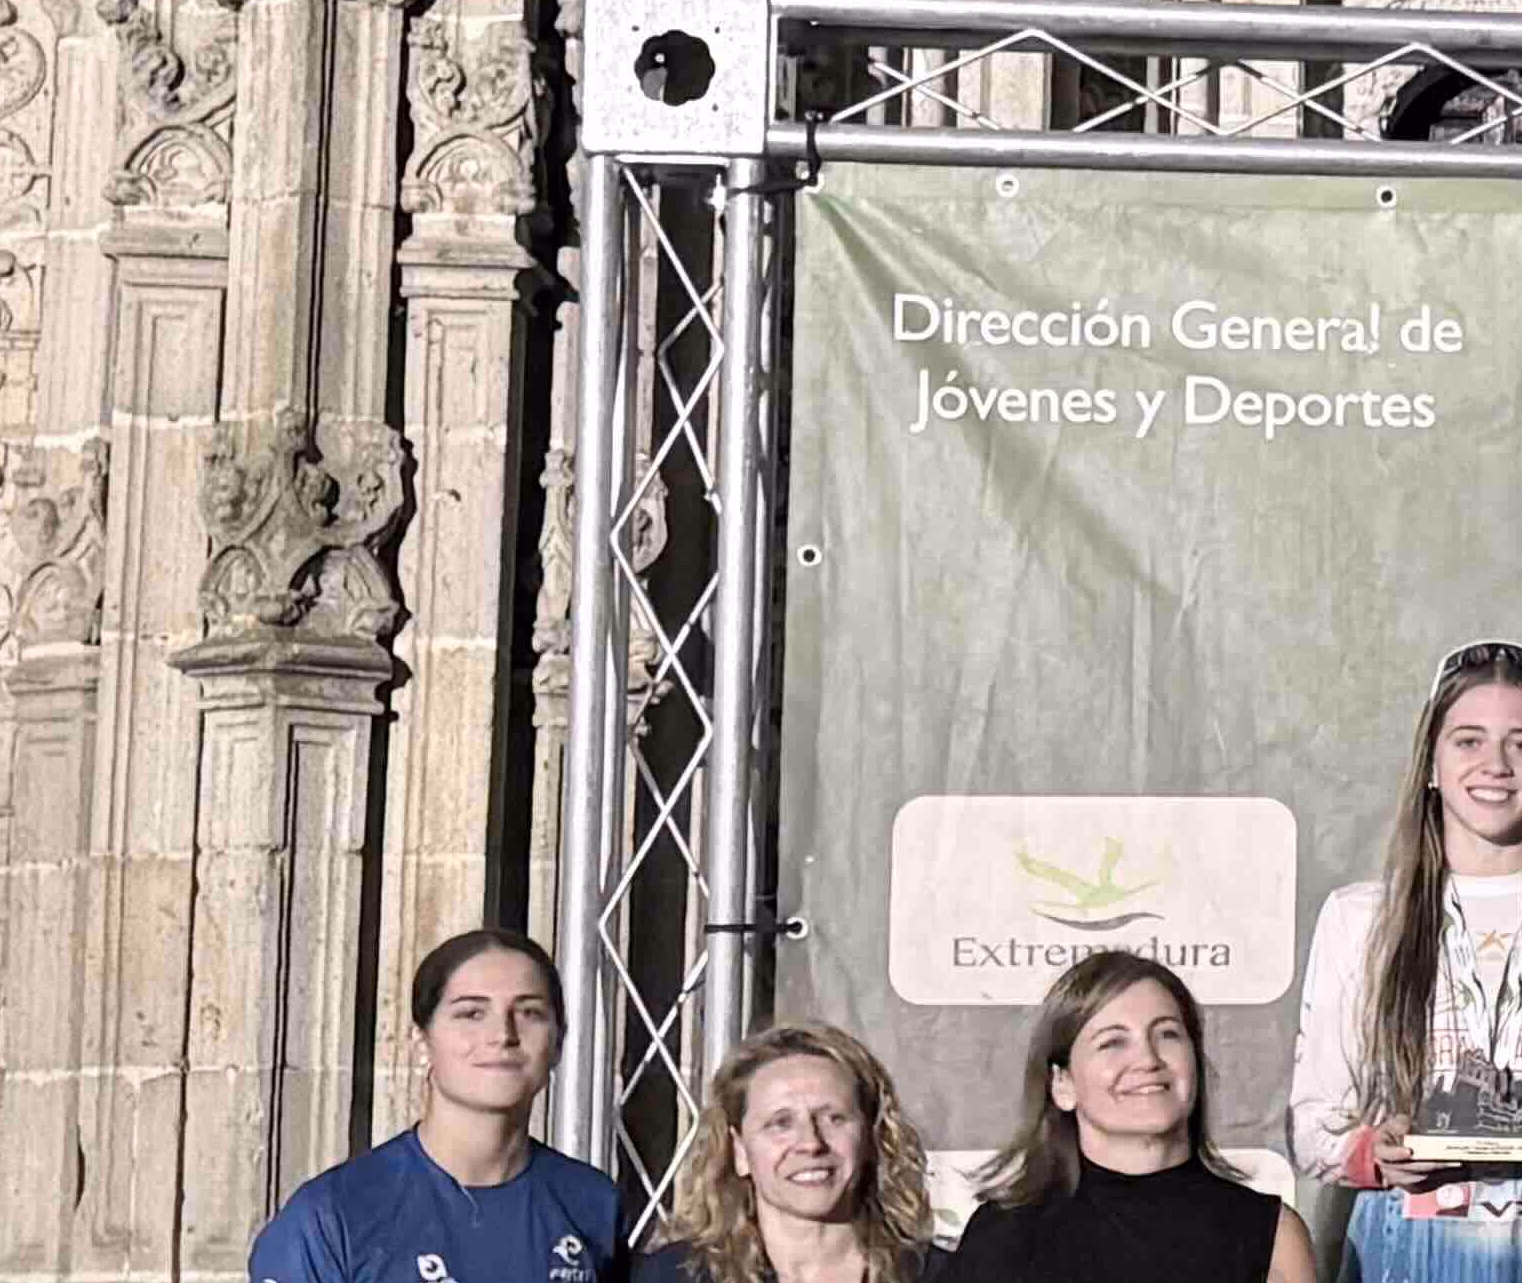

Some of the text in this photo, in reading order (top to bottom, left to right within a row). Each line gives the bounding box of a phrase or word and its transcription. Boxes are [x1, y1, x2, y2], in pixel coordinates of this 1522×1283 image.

[892, 293, 1464, 353] Dirección General de
[910, 368, 1436, 439] Jóvenes y Deportes
[953, 936, 1231, 967] Extredura
